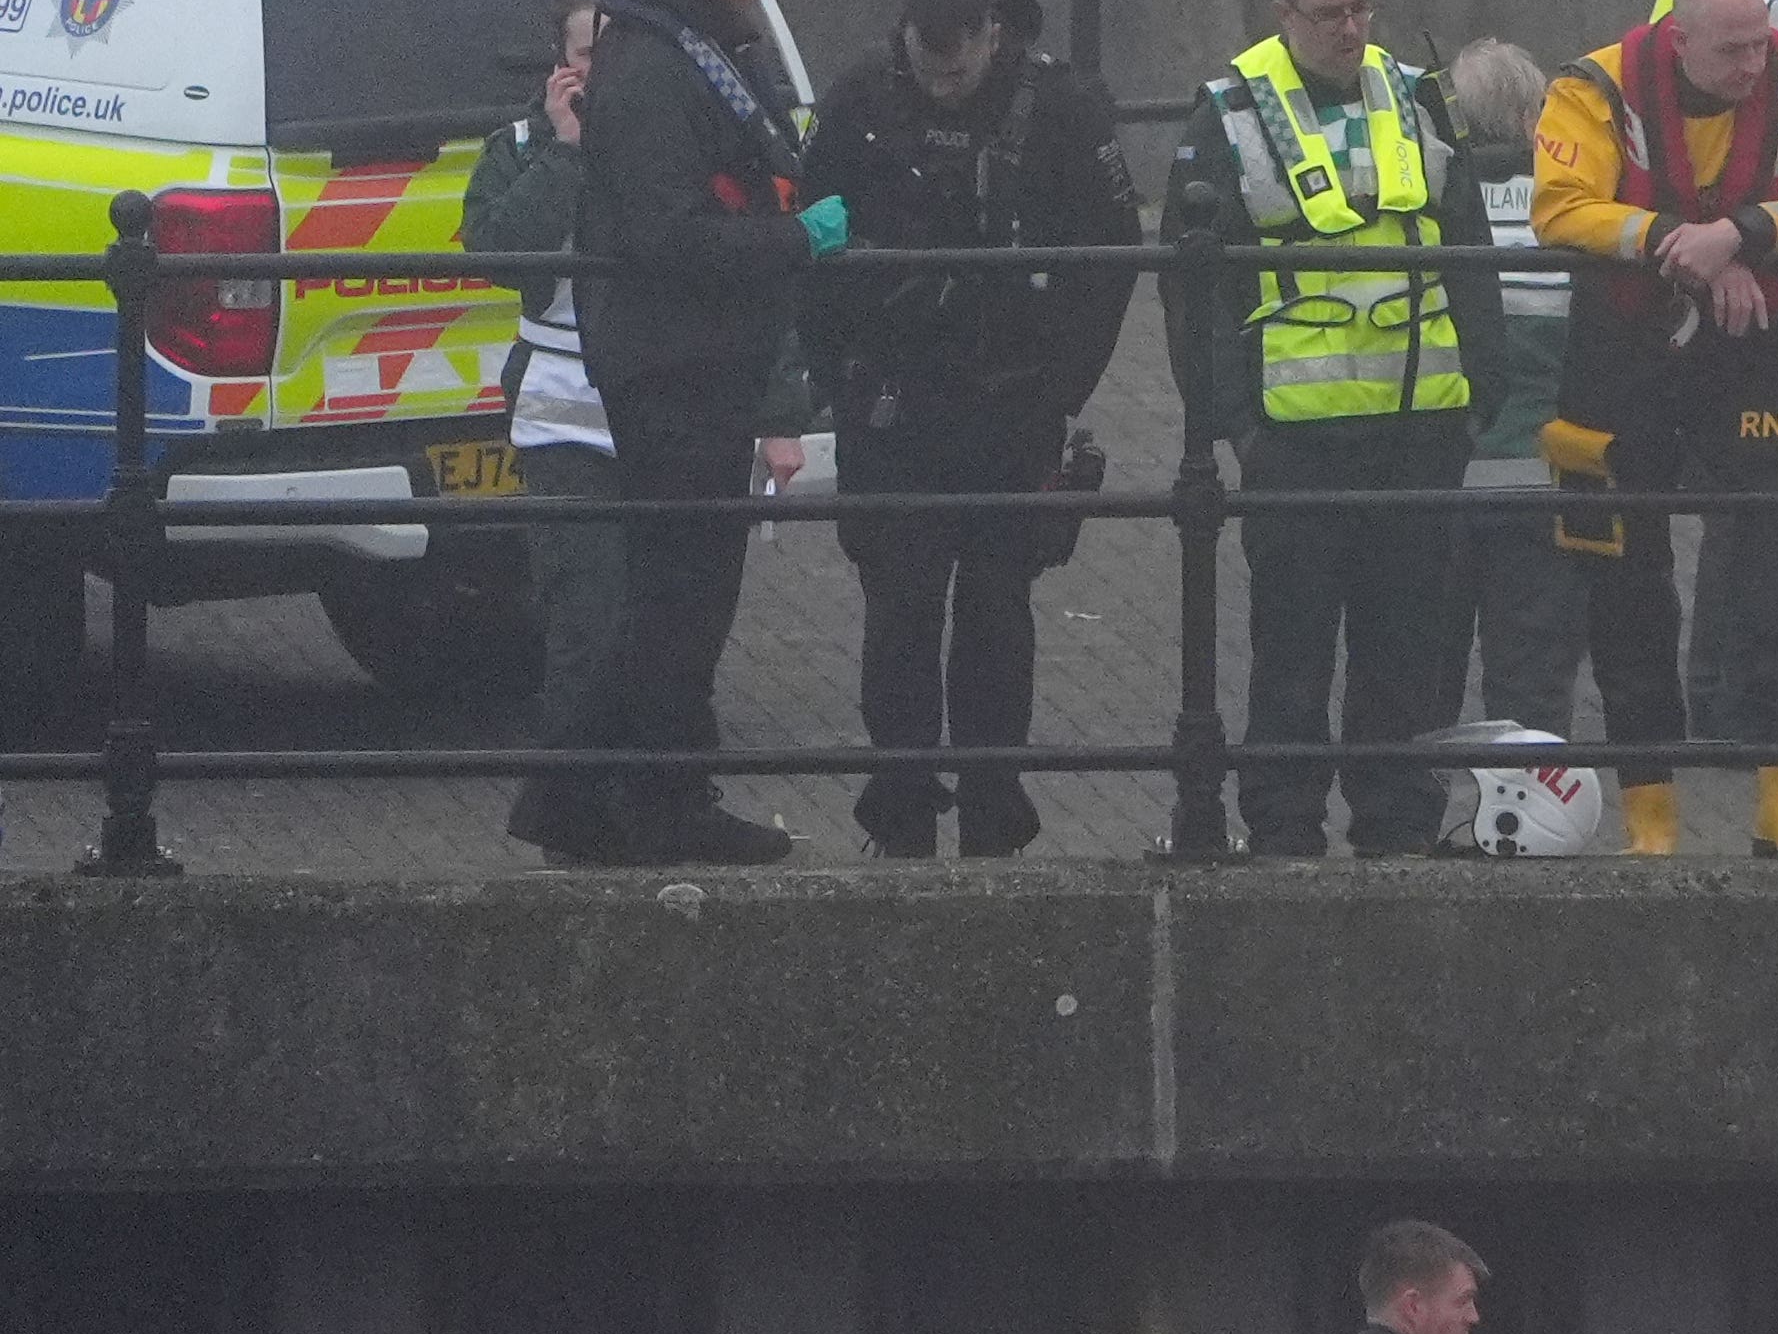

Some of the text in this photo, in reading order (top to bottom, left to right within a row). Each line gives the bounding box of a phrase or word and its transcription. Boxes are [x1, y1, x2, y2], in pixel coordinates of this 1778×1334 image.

[0, 86, 127, 122] .police.uk
[1534, 132, 1580, 168] NLI
[1526, 764, 1582, 805] NLI
